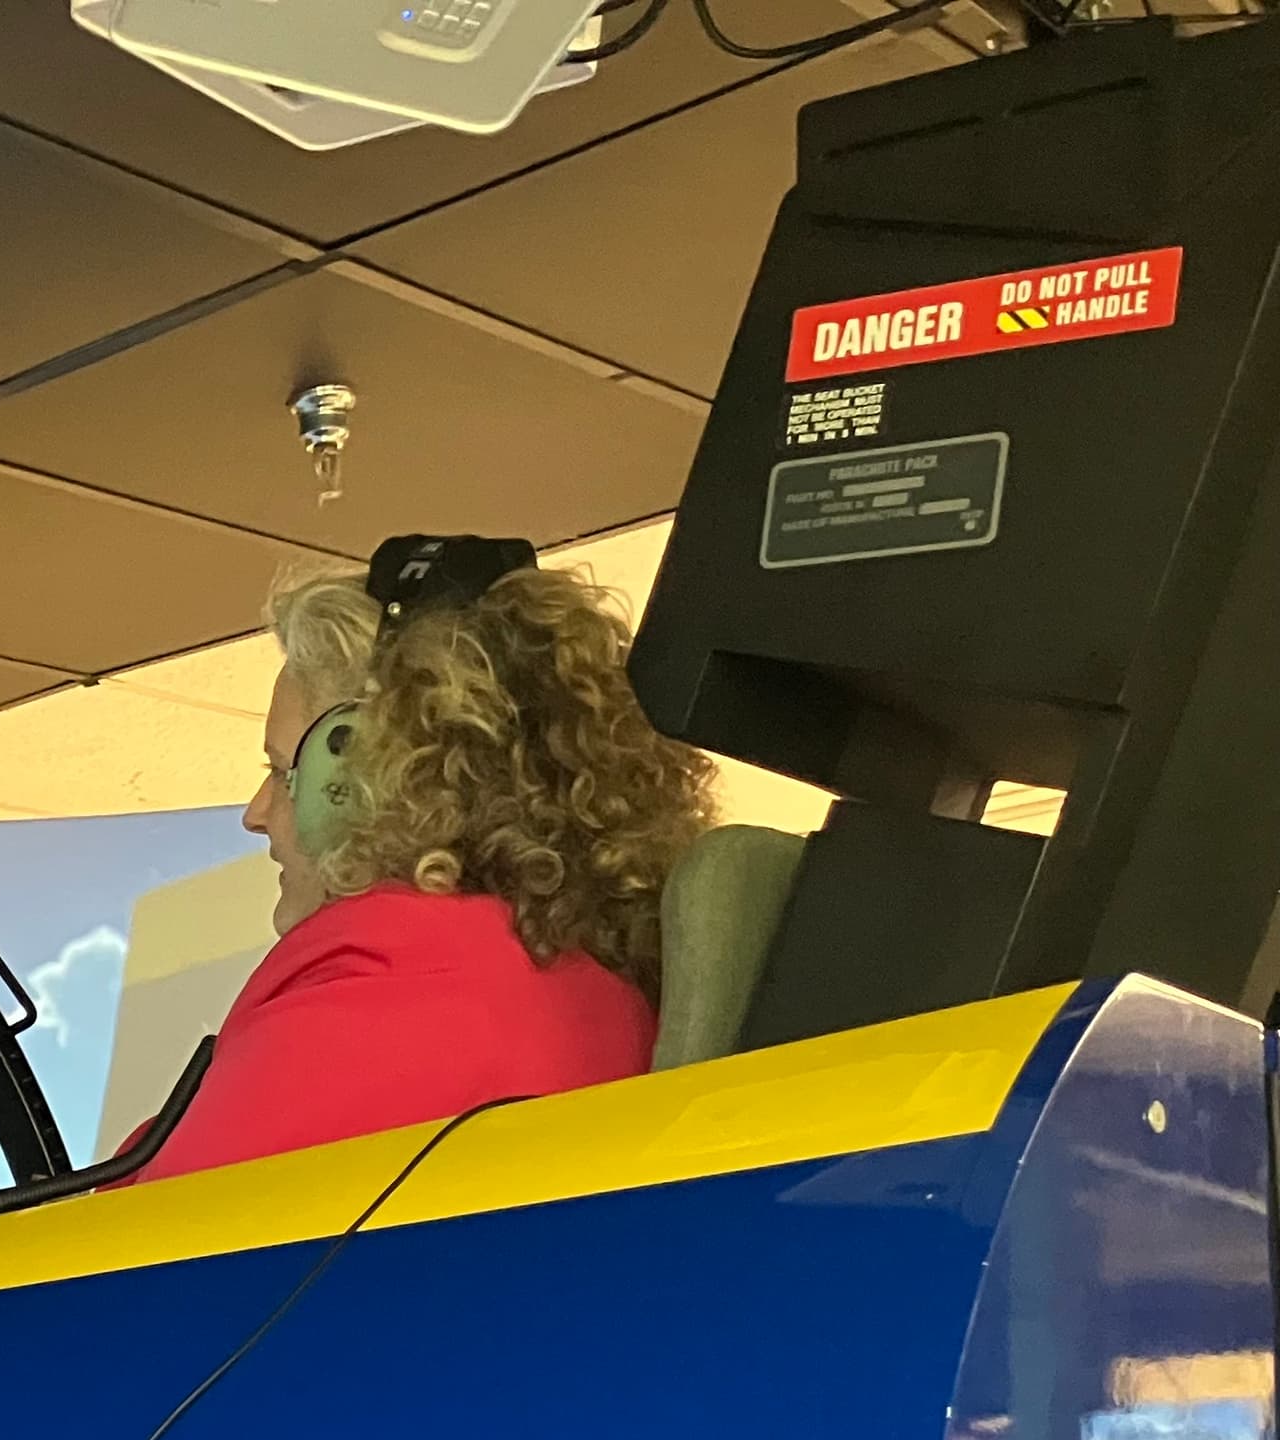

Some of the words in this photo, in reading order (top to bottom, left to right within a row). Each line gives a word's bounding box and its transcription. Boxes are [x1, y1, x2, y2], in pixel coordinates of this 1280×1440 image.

[1000, 280, 1032, 306] DO
[1038, 270, 1089, 300] NOT
[1094, 261, 1152, 291] PULL
[1055, 290, 1149, 326] HANDLE
[813, 301, 964, 362] DANGER
